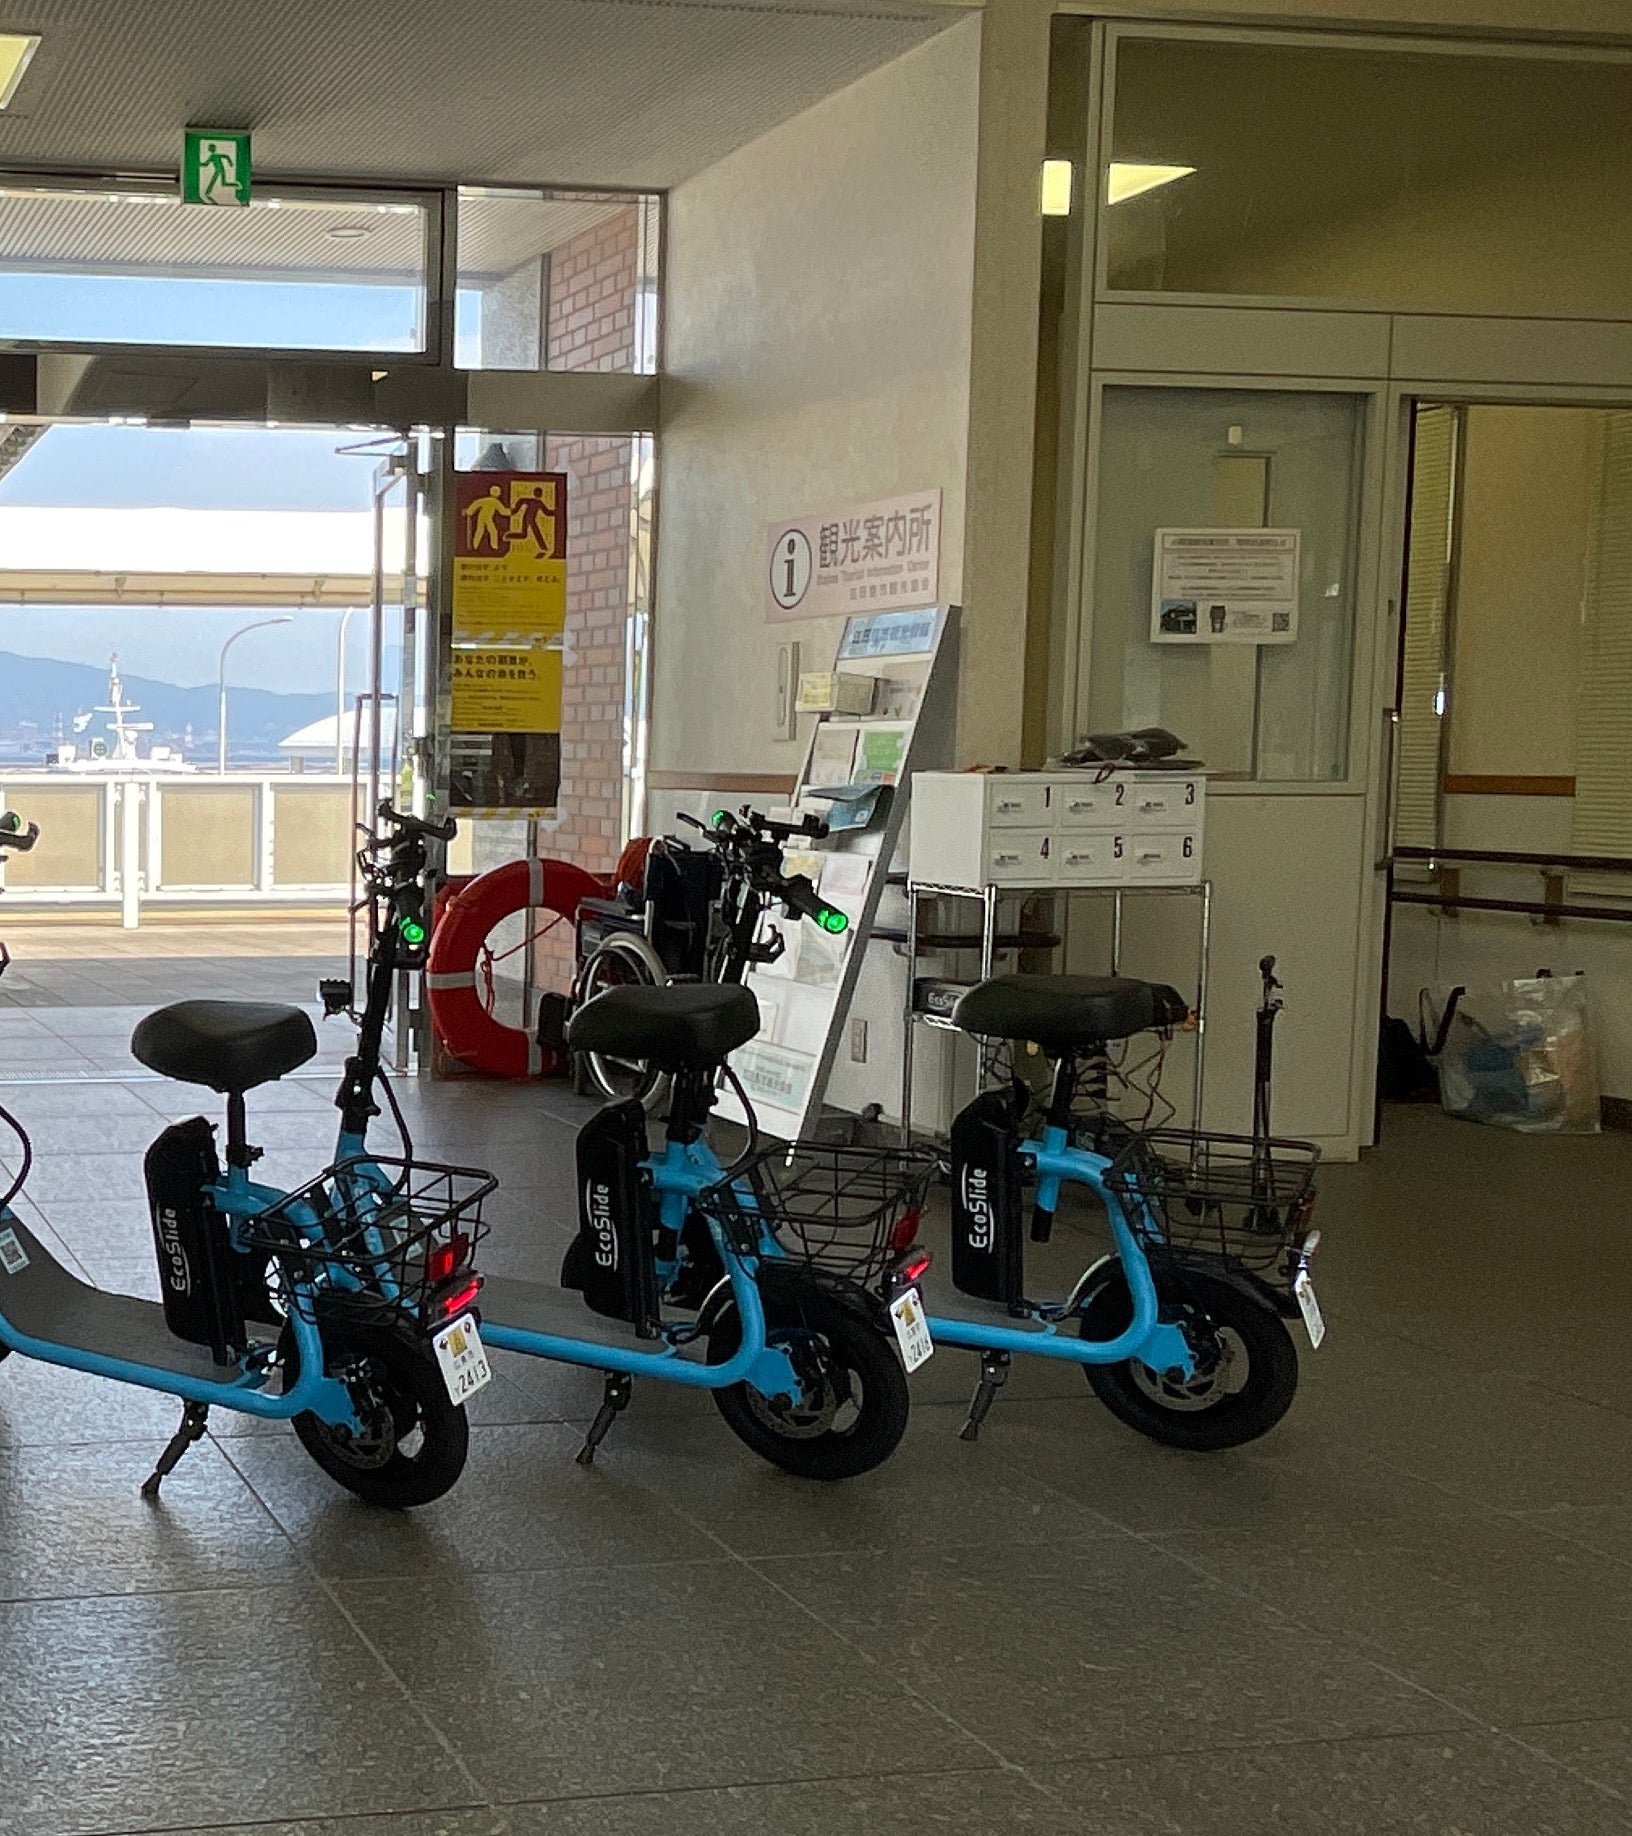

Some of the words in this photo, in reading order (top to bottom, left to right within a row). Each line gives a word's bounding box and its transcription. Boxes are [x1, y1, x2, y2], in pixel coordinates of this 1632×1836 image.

[819, 504, 933, 568] 観光案内所
[1044, 786, 1051, 808] 1
[1115, 783, 1125, 806] 2
[1185, 783, 1195, 805] 3
[1040, 837, 1049, 859] 4
[1114, 836, 1123, 858] 5
[1183, 836, 1193, 857] 6
[968, 1168, 988, 1249] EcoSlide
[593, 1184, 612, 1266] EcoSlide
[162, 1207, 187, 1291] EcoSlide
[459, 1359, 487, 1394] 2413
